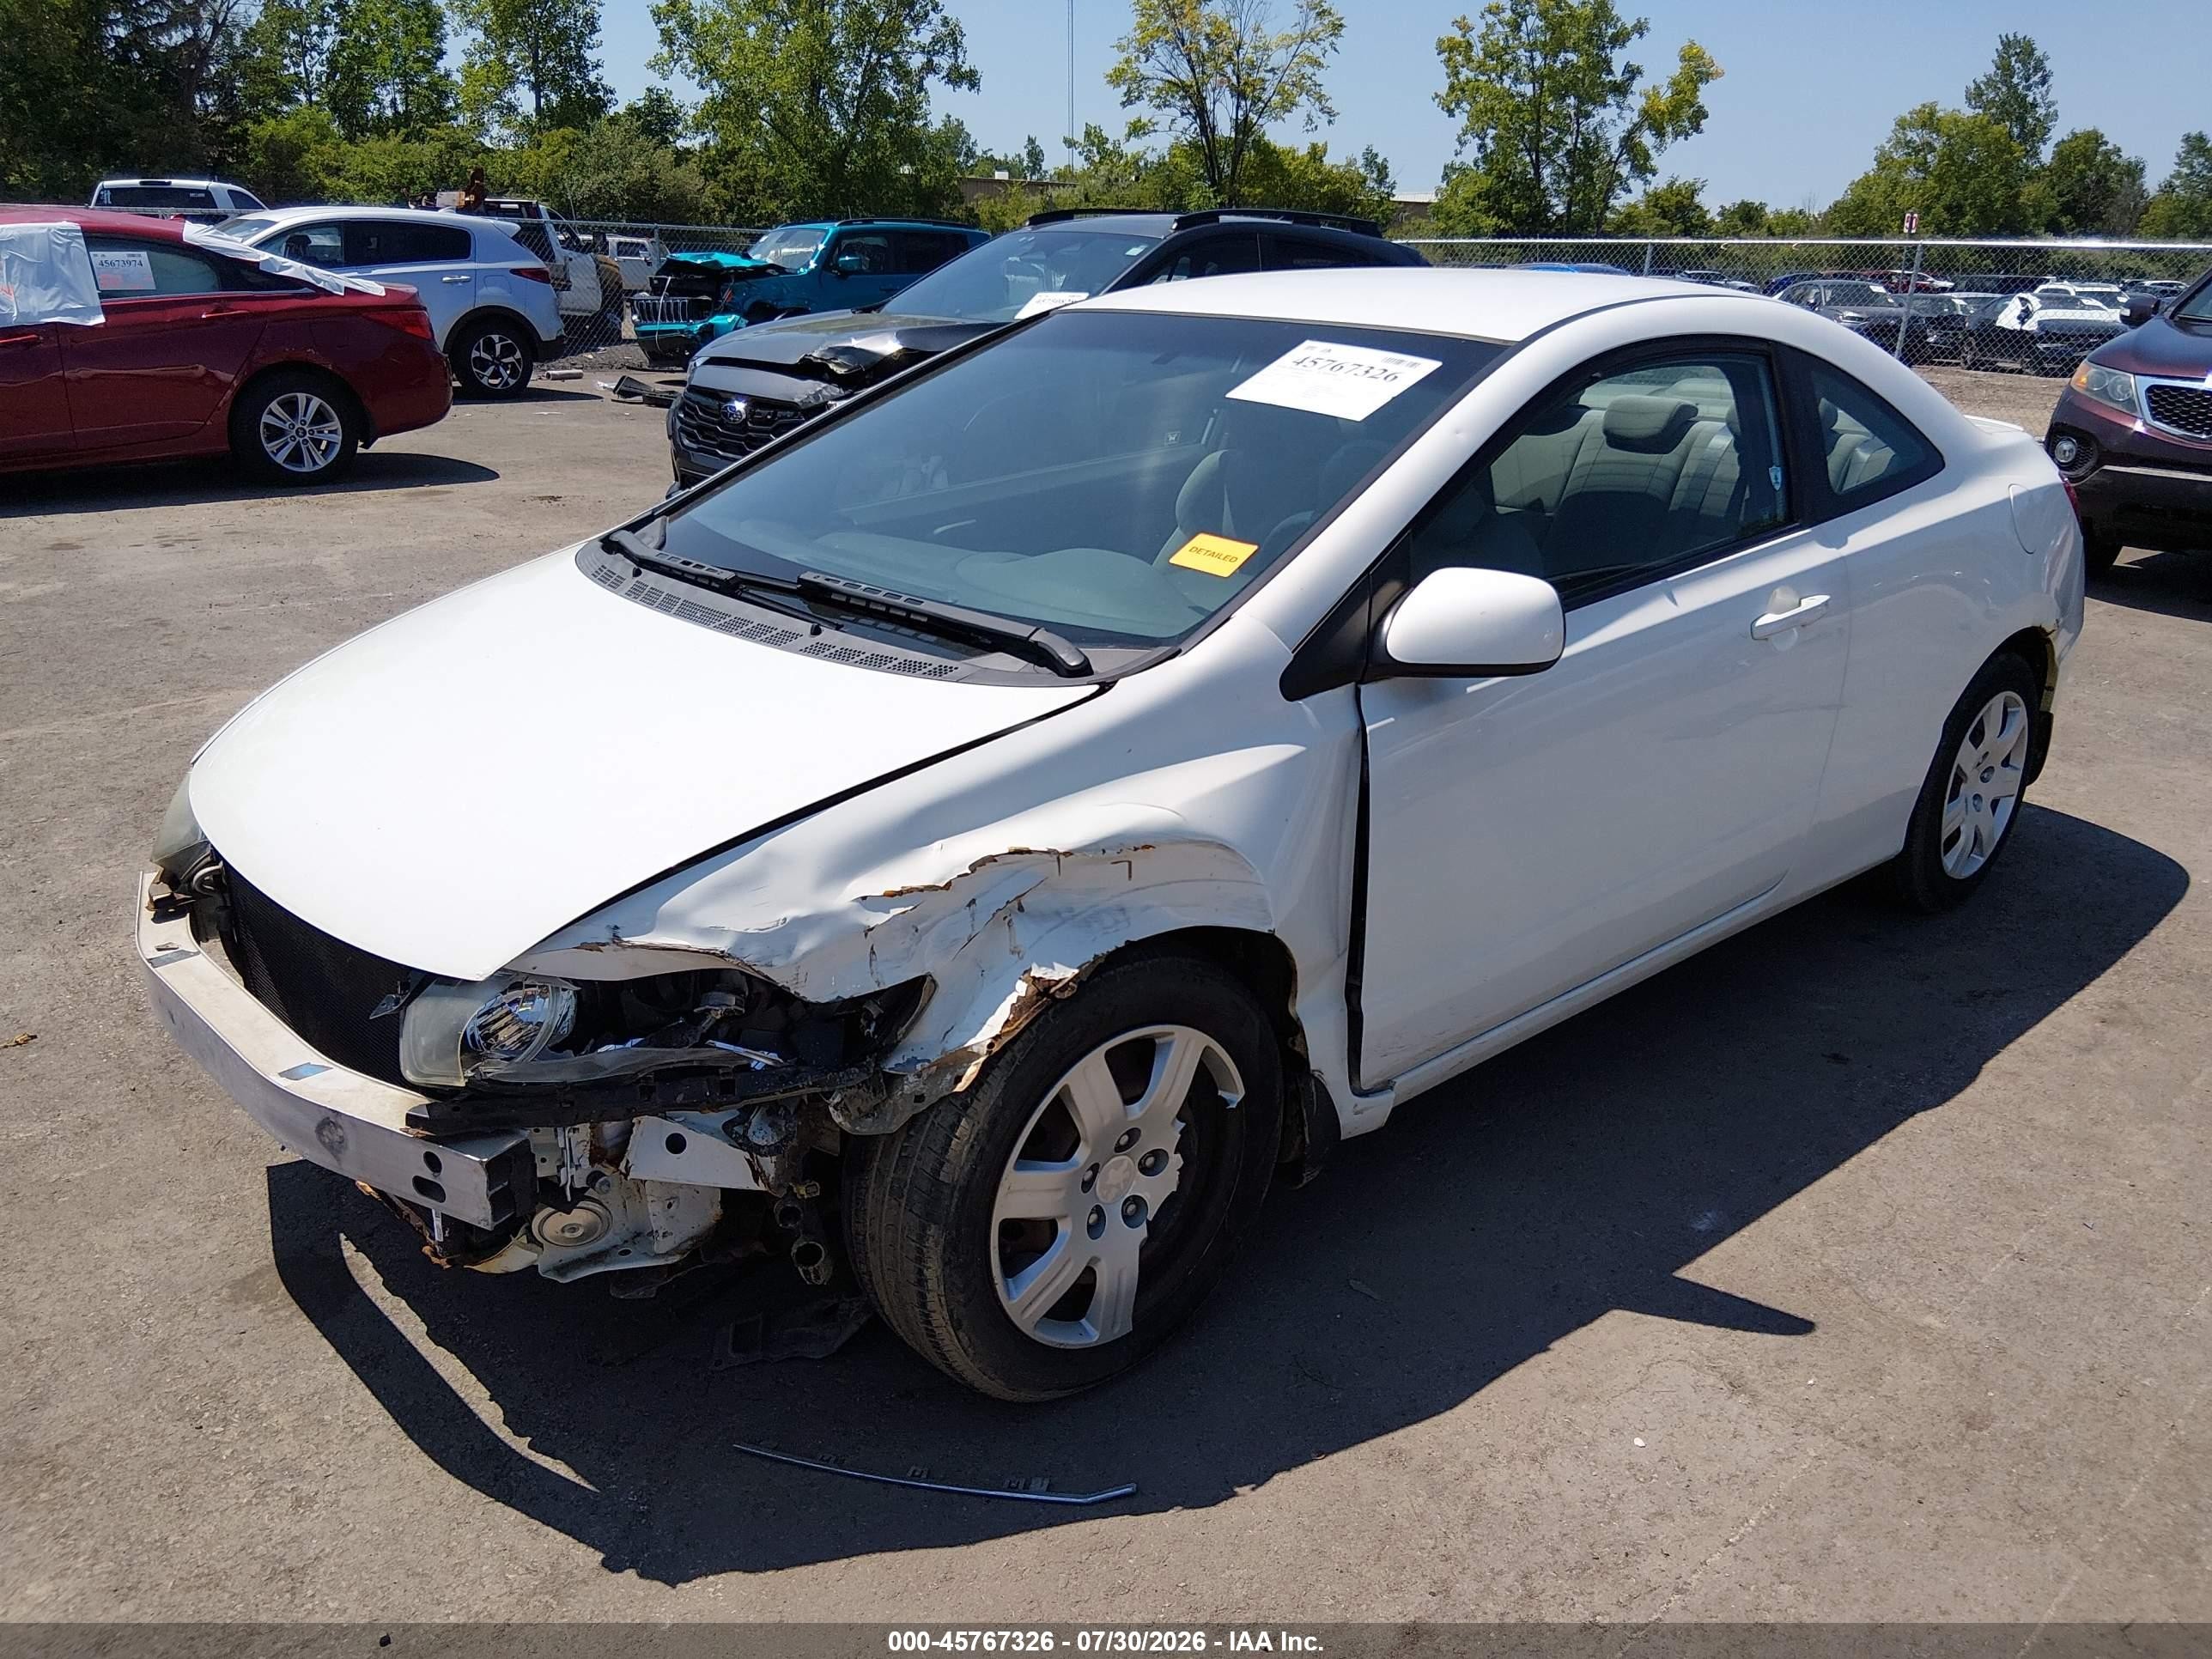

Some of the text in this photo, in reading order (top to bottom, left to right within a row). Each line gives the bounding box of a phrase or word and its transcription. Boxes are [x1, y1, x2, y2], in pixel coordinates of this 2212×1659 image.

[98, 259, 143, 268] 45673974
[1291, 356, 1402, 383] 45767326
[1188, 545, 1238, 563] DETAILED
